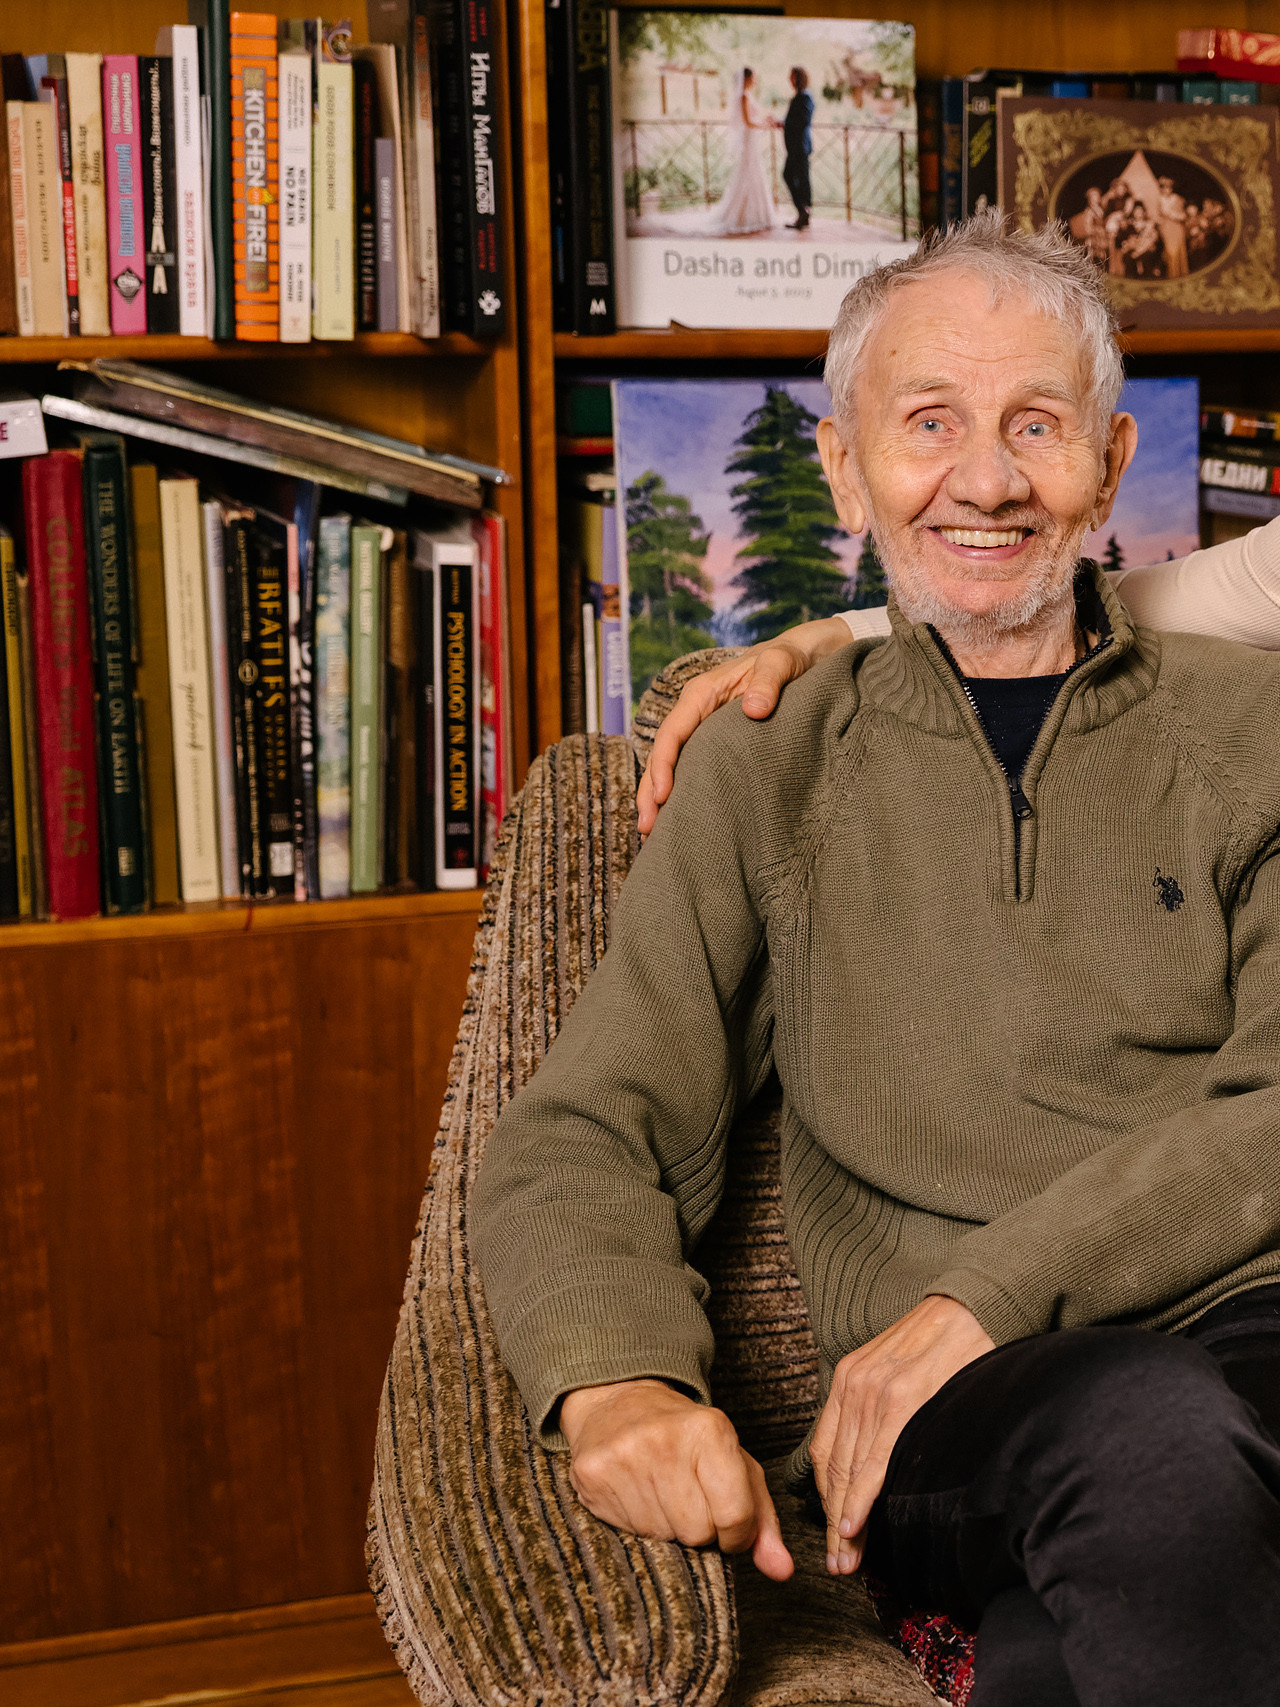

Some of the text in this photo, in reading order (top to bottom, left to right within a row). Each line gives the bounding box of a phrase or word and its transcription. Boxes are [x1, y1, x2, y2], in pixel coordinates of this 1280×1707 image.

[469, 52, 490, 106] Игры
[244, 87, 267, 188] KITCHEN
[246, 204, 268, 263] FIRE!
[664, 250, 744, 278] Dasha
[753, 253, 802, 279] and
[98, 481, 130, 794] THE WONDERS OF LIFE ON EARTH
[257, 582, 287, 708] BEATLES
[447, 612, 466, 721] PSYCHOLOGY
[448, 726, 467, 744] IN
[60, 765, 88, 858] ATLAS
[448, 748, 469, 812] ACTION
